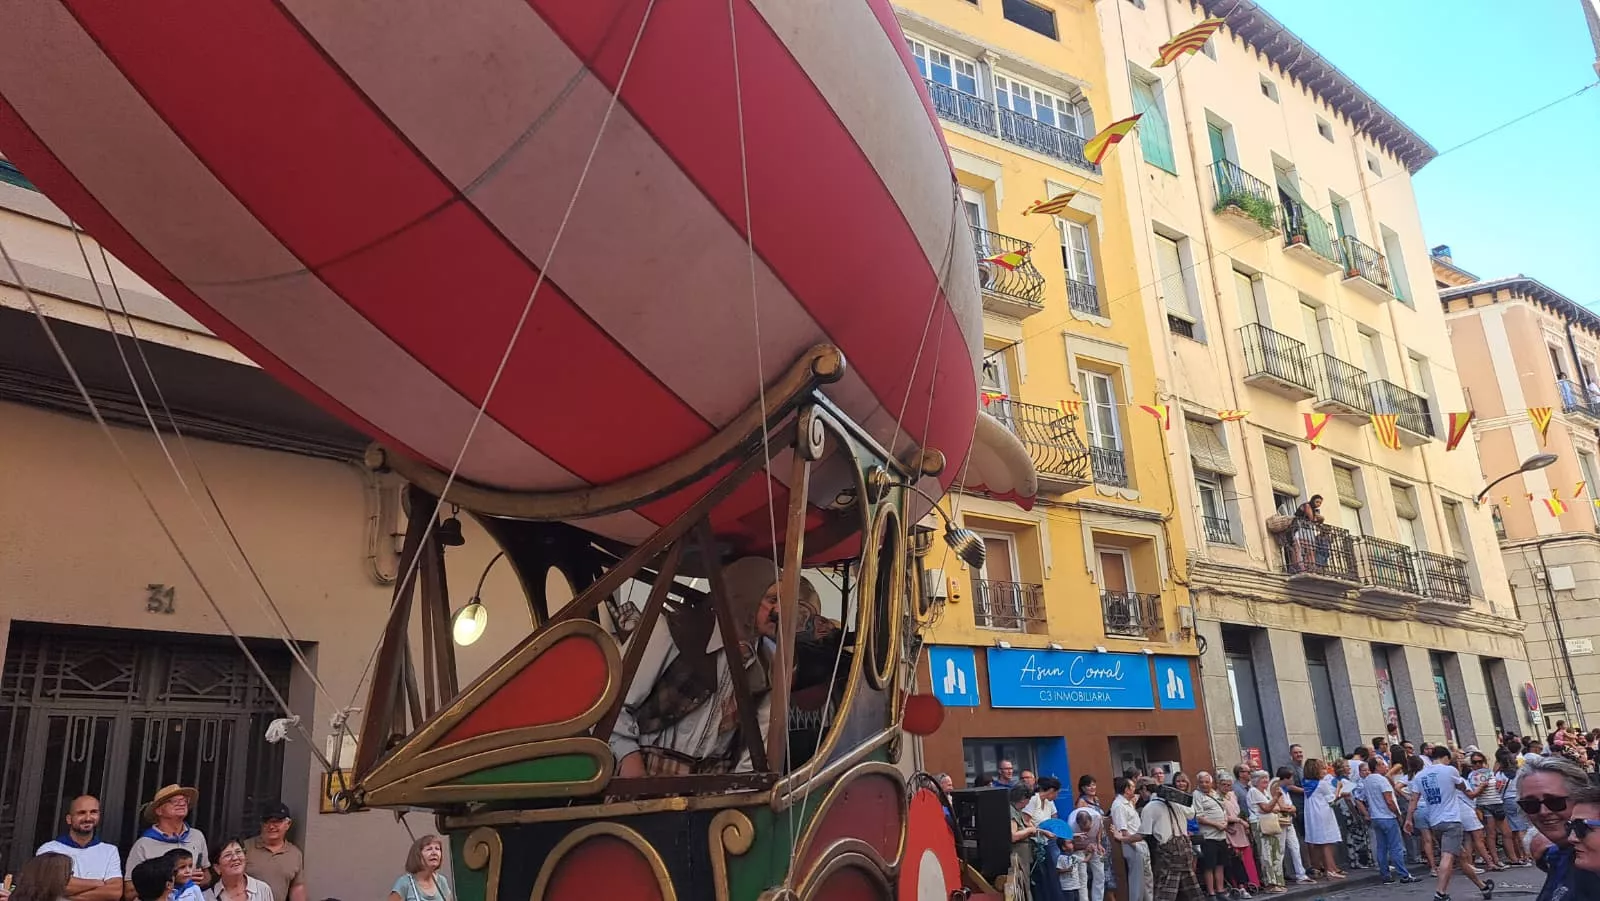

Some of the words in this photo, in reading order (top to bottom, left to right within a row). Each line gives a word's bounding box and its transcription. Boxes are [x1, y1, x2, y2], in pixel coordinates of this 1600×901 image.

[146, 583, 175, 614] 31
[1020, 654, 1064, 681] Asun
[1069, 655, 1124, 685] Corral
[1039, 690, 1052, 701] C3
[1054, 691, 1112, 702] INMOBILIARIA
